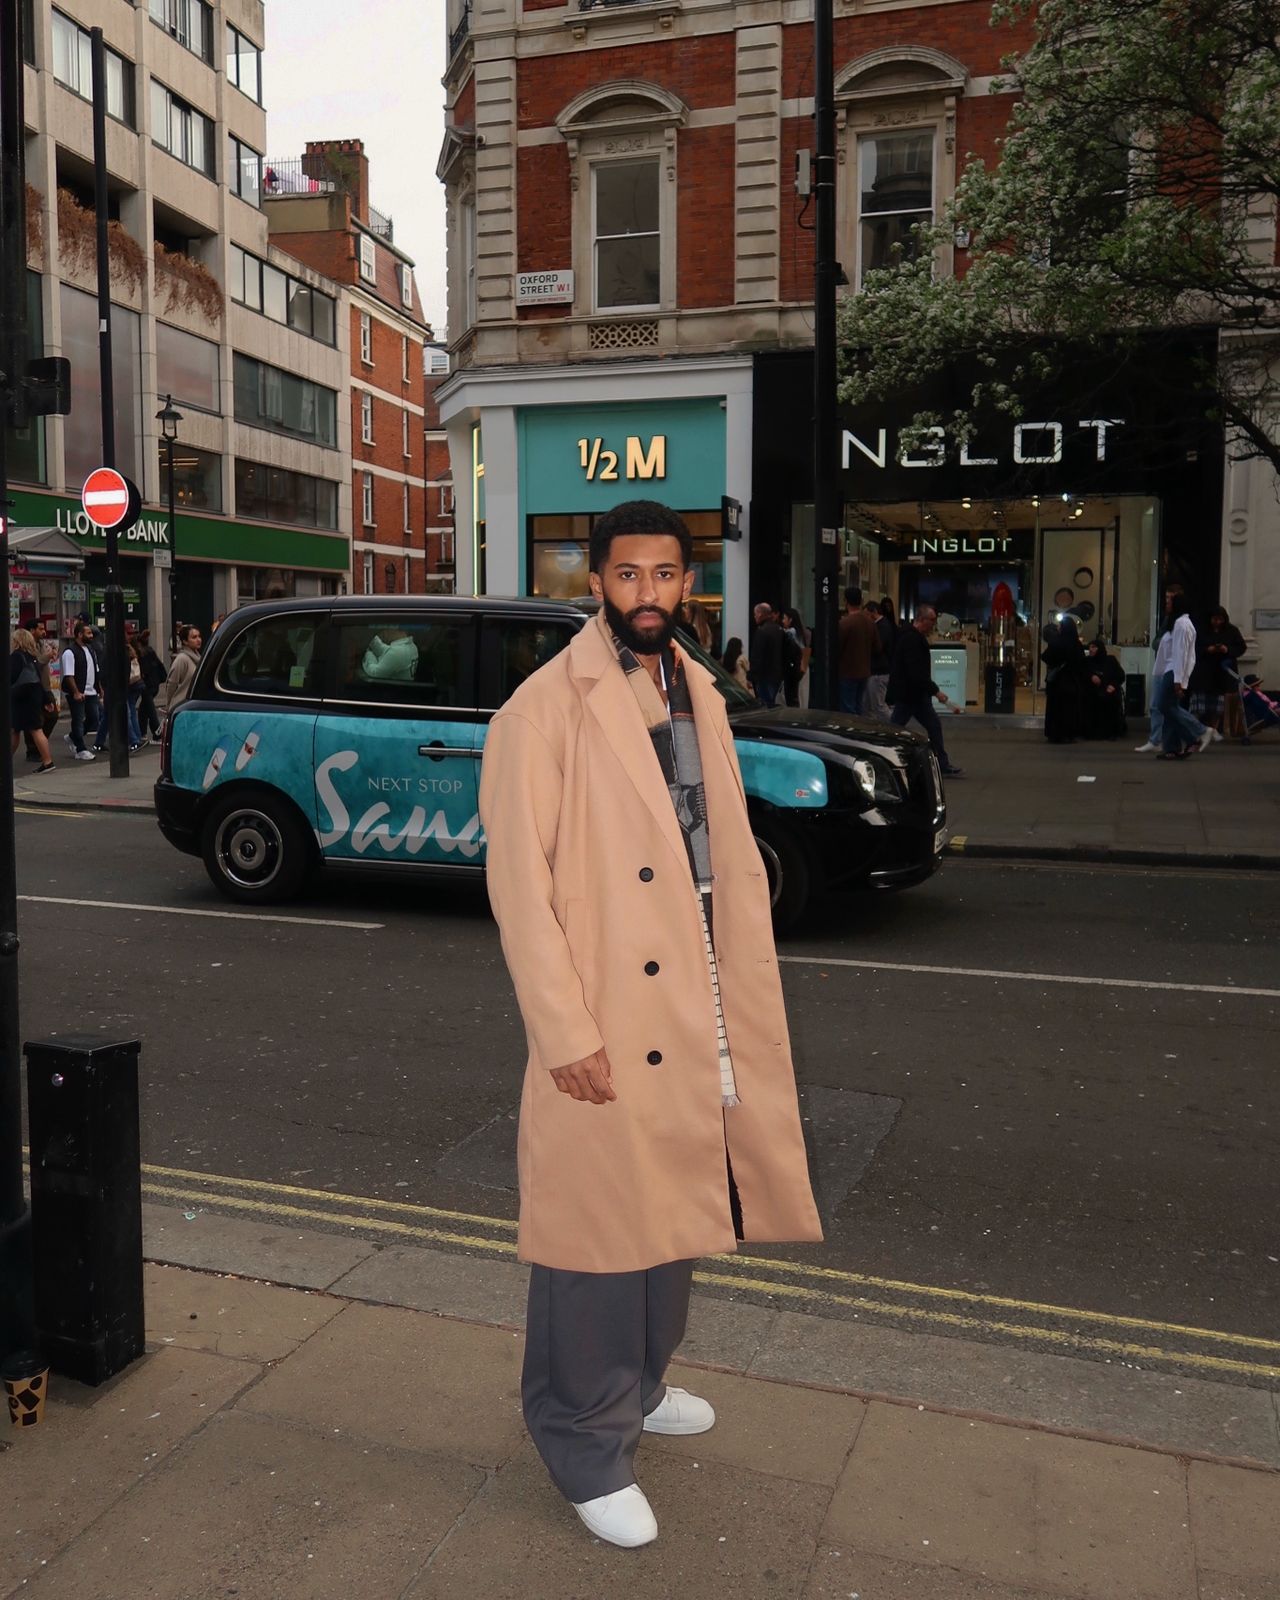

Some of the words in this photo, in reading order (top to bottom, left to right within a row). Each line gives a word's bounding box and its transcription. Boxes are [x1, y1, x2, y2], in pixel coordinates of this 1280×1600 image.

[520, 274, 558, 285] OXFORD
[520, 285, 554, 295] STREET
[557, 284, 570, 292] W1
[842, 420, 1125, 469] NGLOT
[127, 519, 169, 543] BANK
[913, 538, 1012, 553] INGLOT
[368, 777, 411, 792] NEXT
[419, 778, 463, 794] STOP
